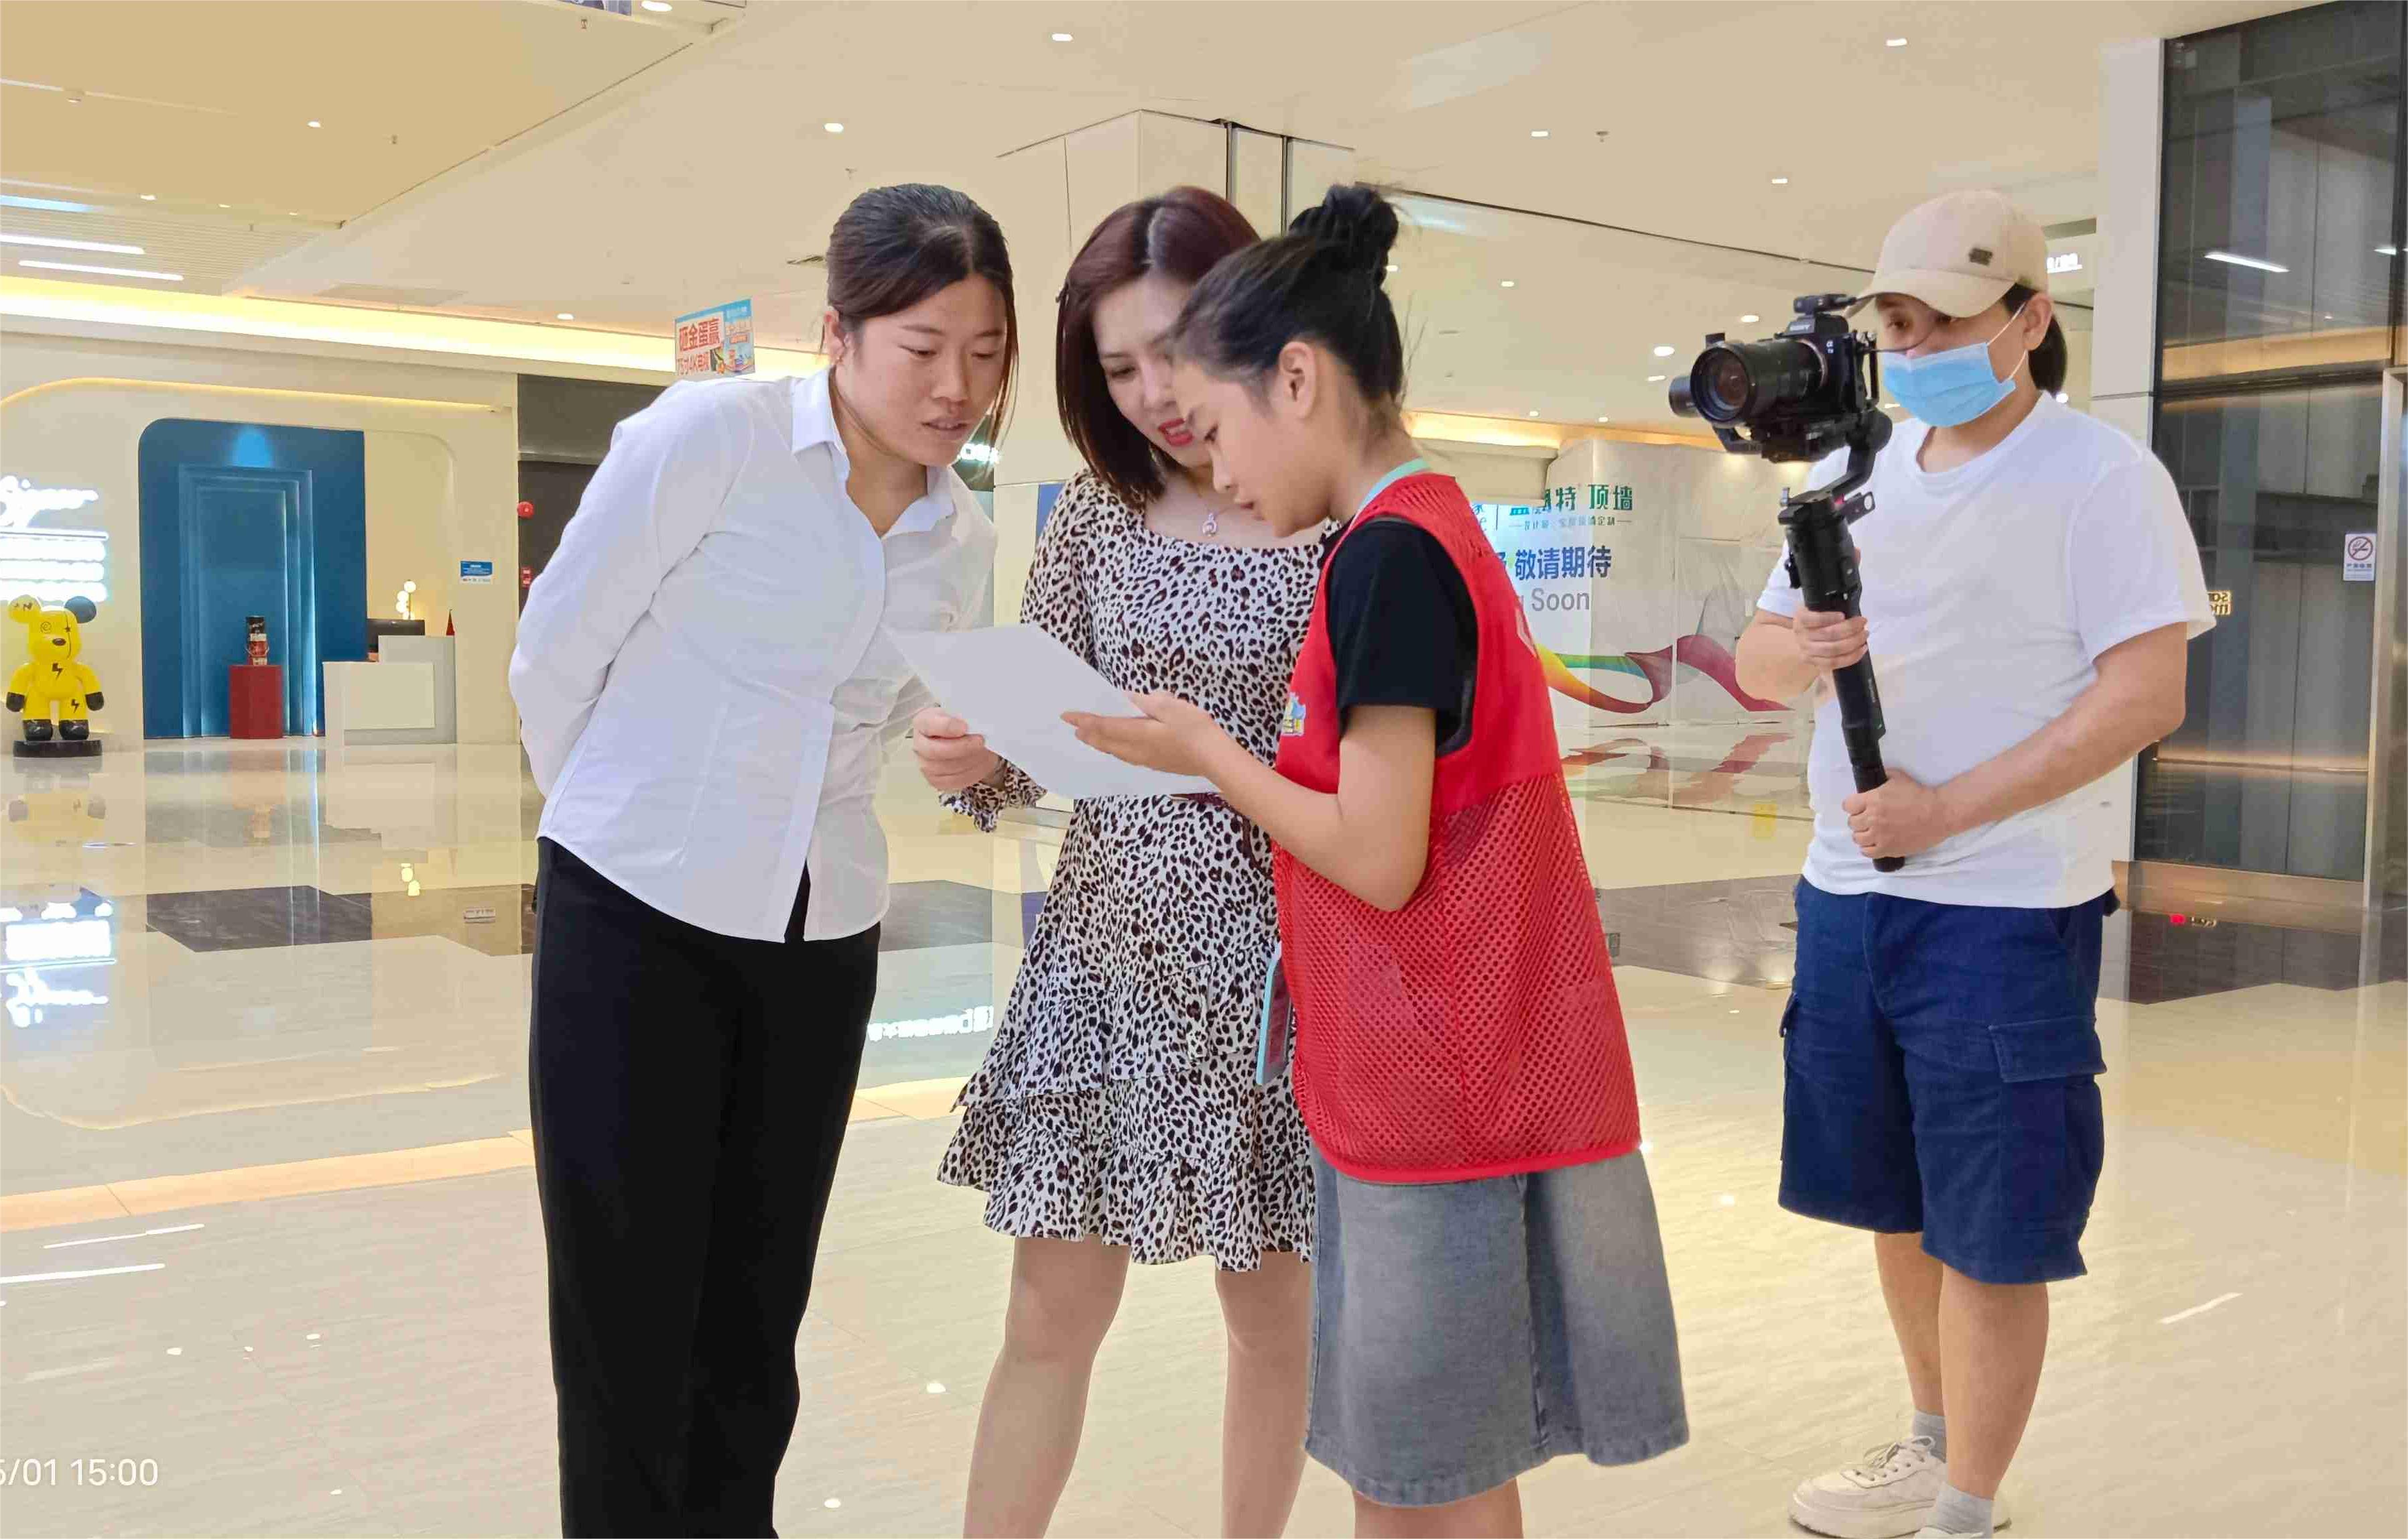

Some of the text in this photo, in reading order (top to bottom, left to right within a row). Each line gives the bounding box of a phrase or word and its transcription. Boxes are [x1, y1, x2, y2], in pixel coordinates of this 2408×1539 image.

[1588, 484, 1633, 511] 顶墙
[1515, 545, 1612, 581] 敬请期待
[1531, 587, 1590, 612] Soon
